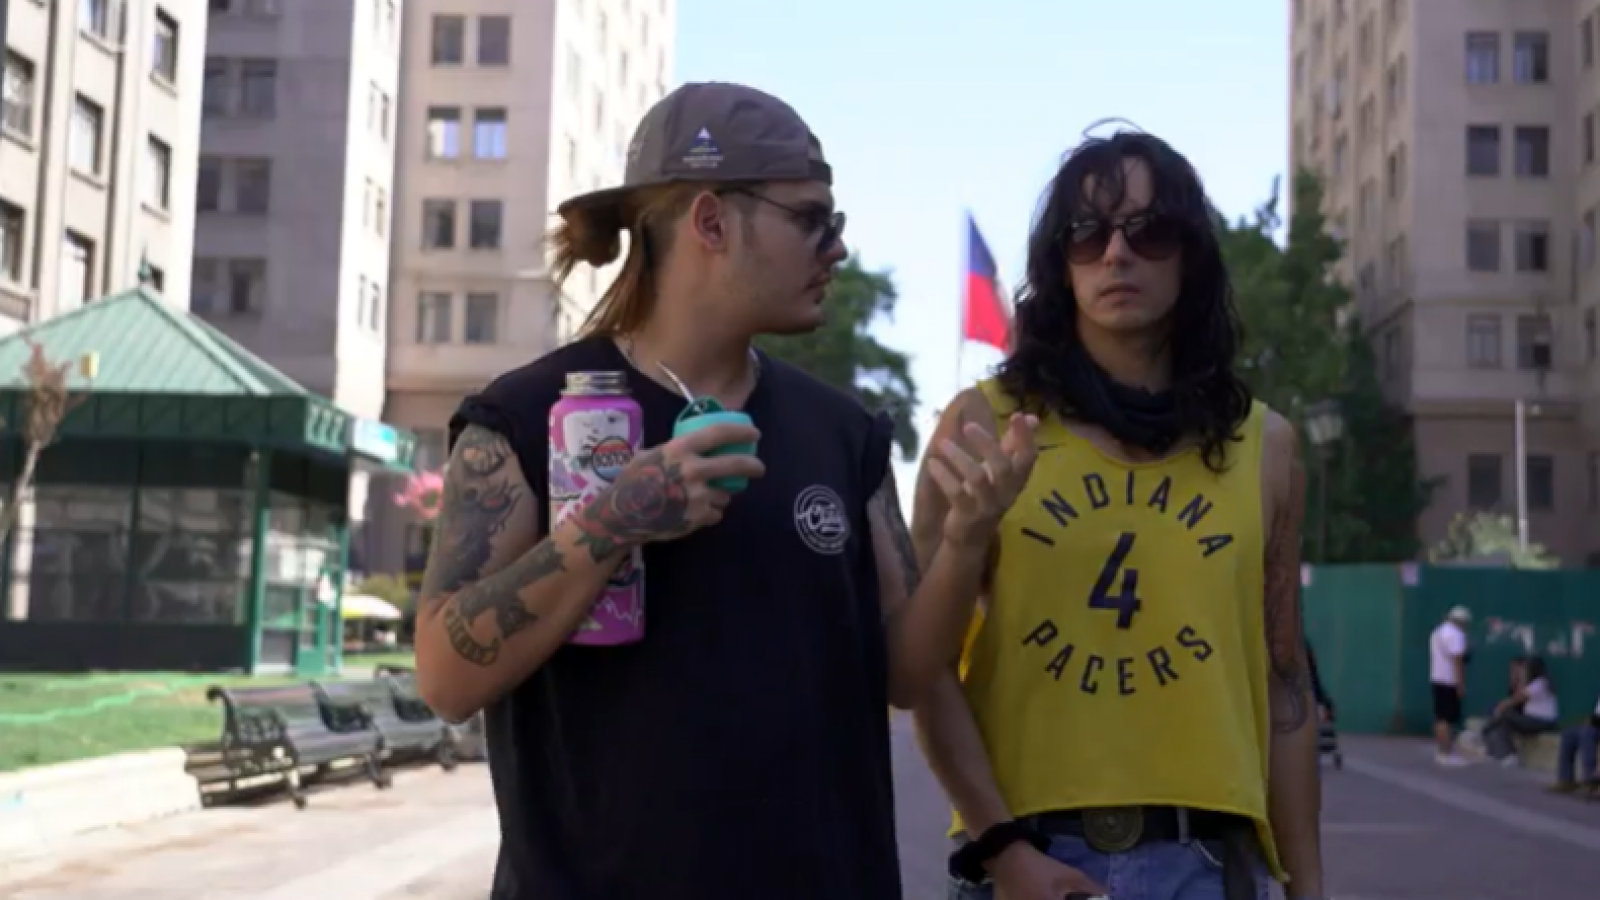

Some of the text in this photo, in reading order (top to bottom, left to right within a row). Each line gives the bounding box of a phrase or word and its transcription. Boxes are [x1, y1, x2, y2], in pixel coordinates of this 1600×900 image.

[1021, 470, 1233, 557] INDIANA
[1088, 532, 1142, 629] 4
[1021, 618, 1214, 696] PACERS
